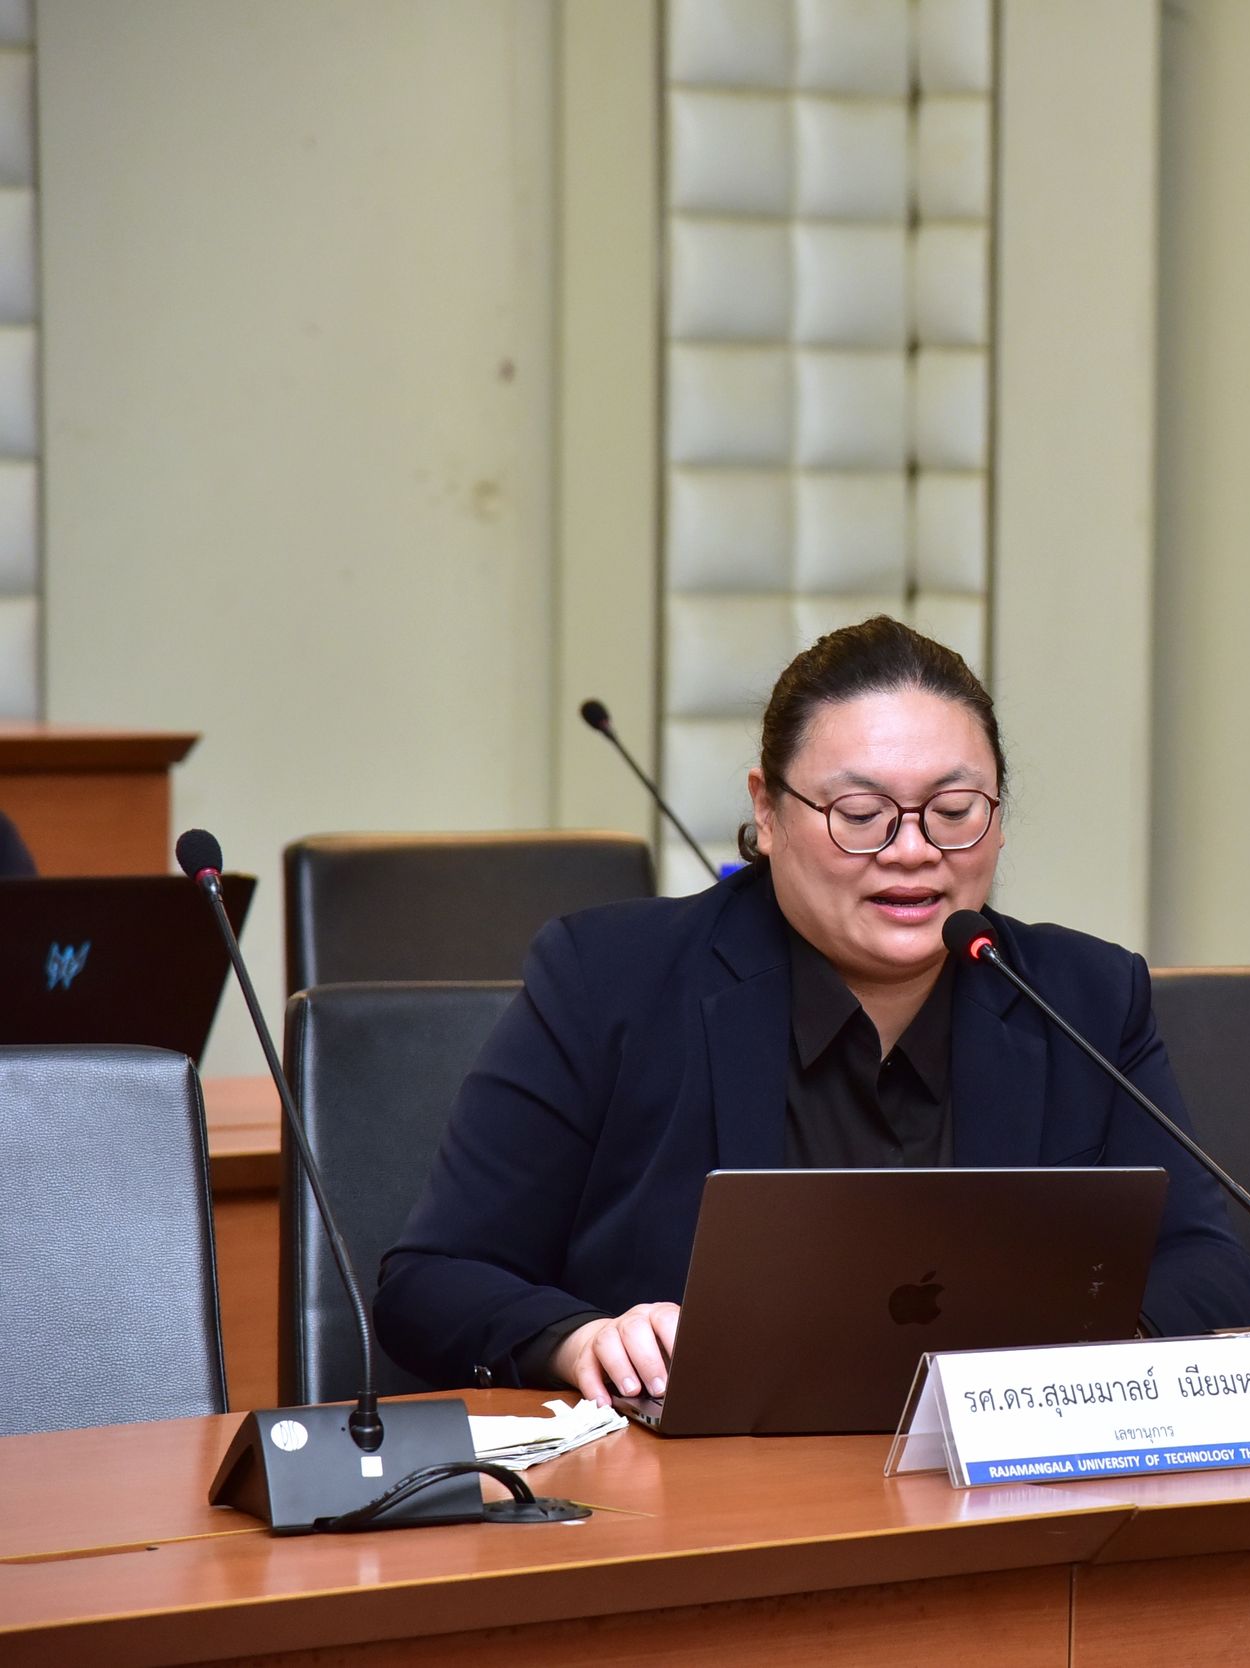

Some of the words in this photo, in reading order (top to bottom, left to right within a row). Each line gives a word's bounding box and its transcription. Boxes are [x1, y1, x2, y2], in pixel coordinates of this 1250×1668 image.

[964, 1365, 1159, 1418] รศ.ดร.สุมนมาลย์
[1114, 1425, 1175, 1444] เลขานุการ
[988, 1460, 1074, 1479] RAJAMANGALA
[1078, 1455, 1140, 1472] UNIVERSITY
[1145, 1453, 1160, 1467] OF
[1164, 1448, 1235, 1465] TECHNOLOGY
